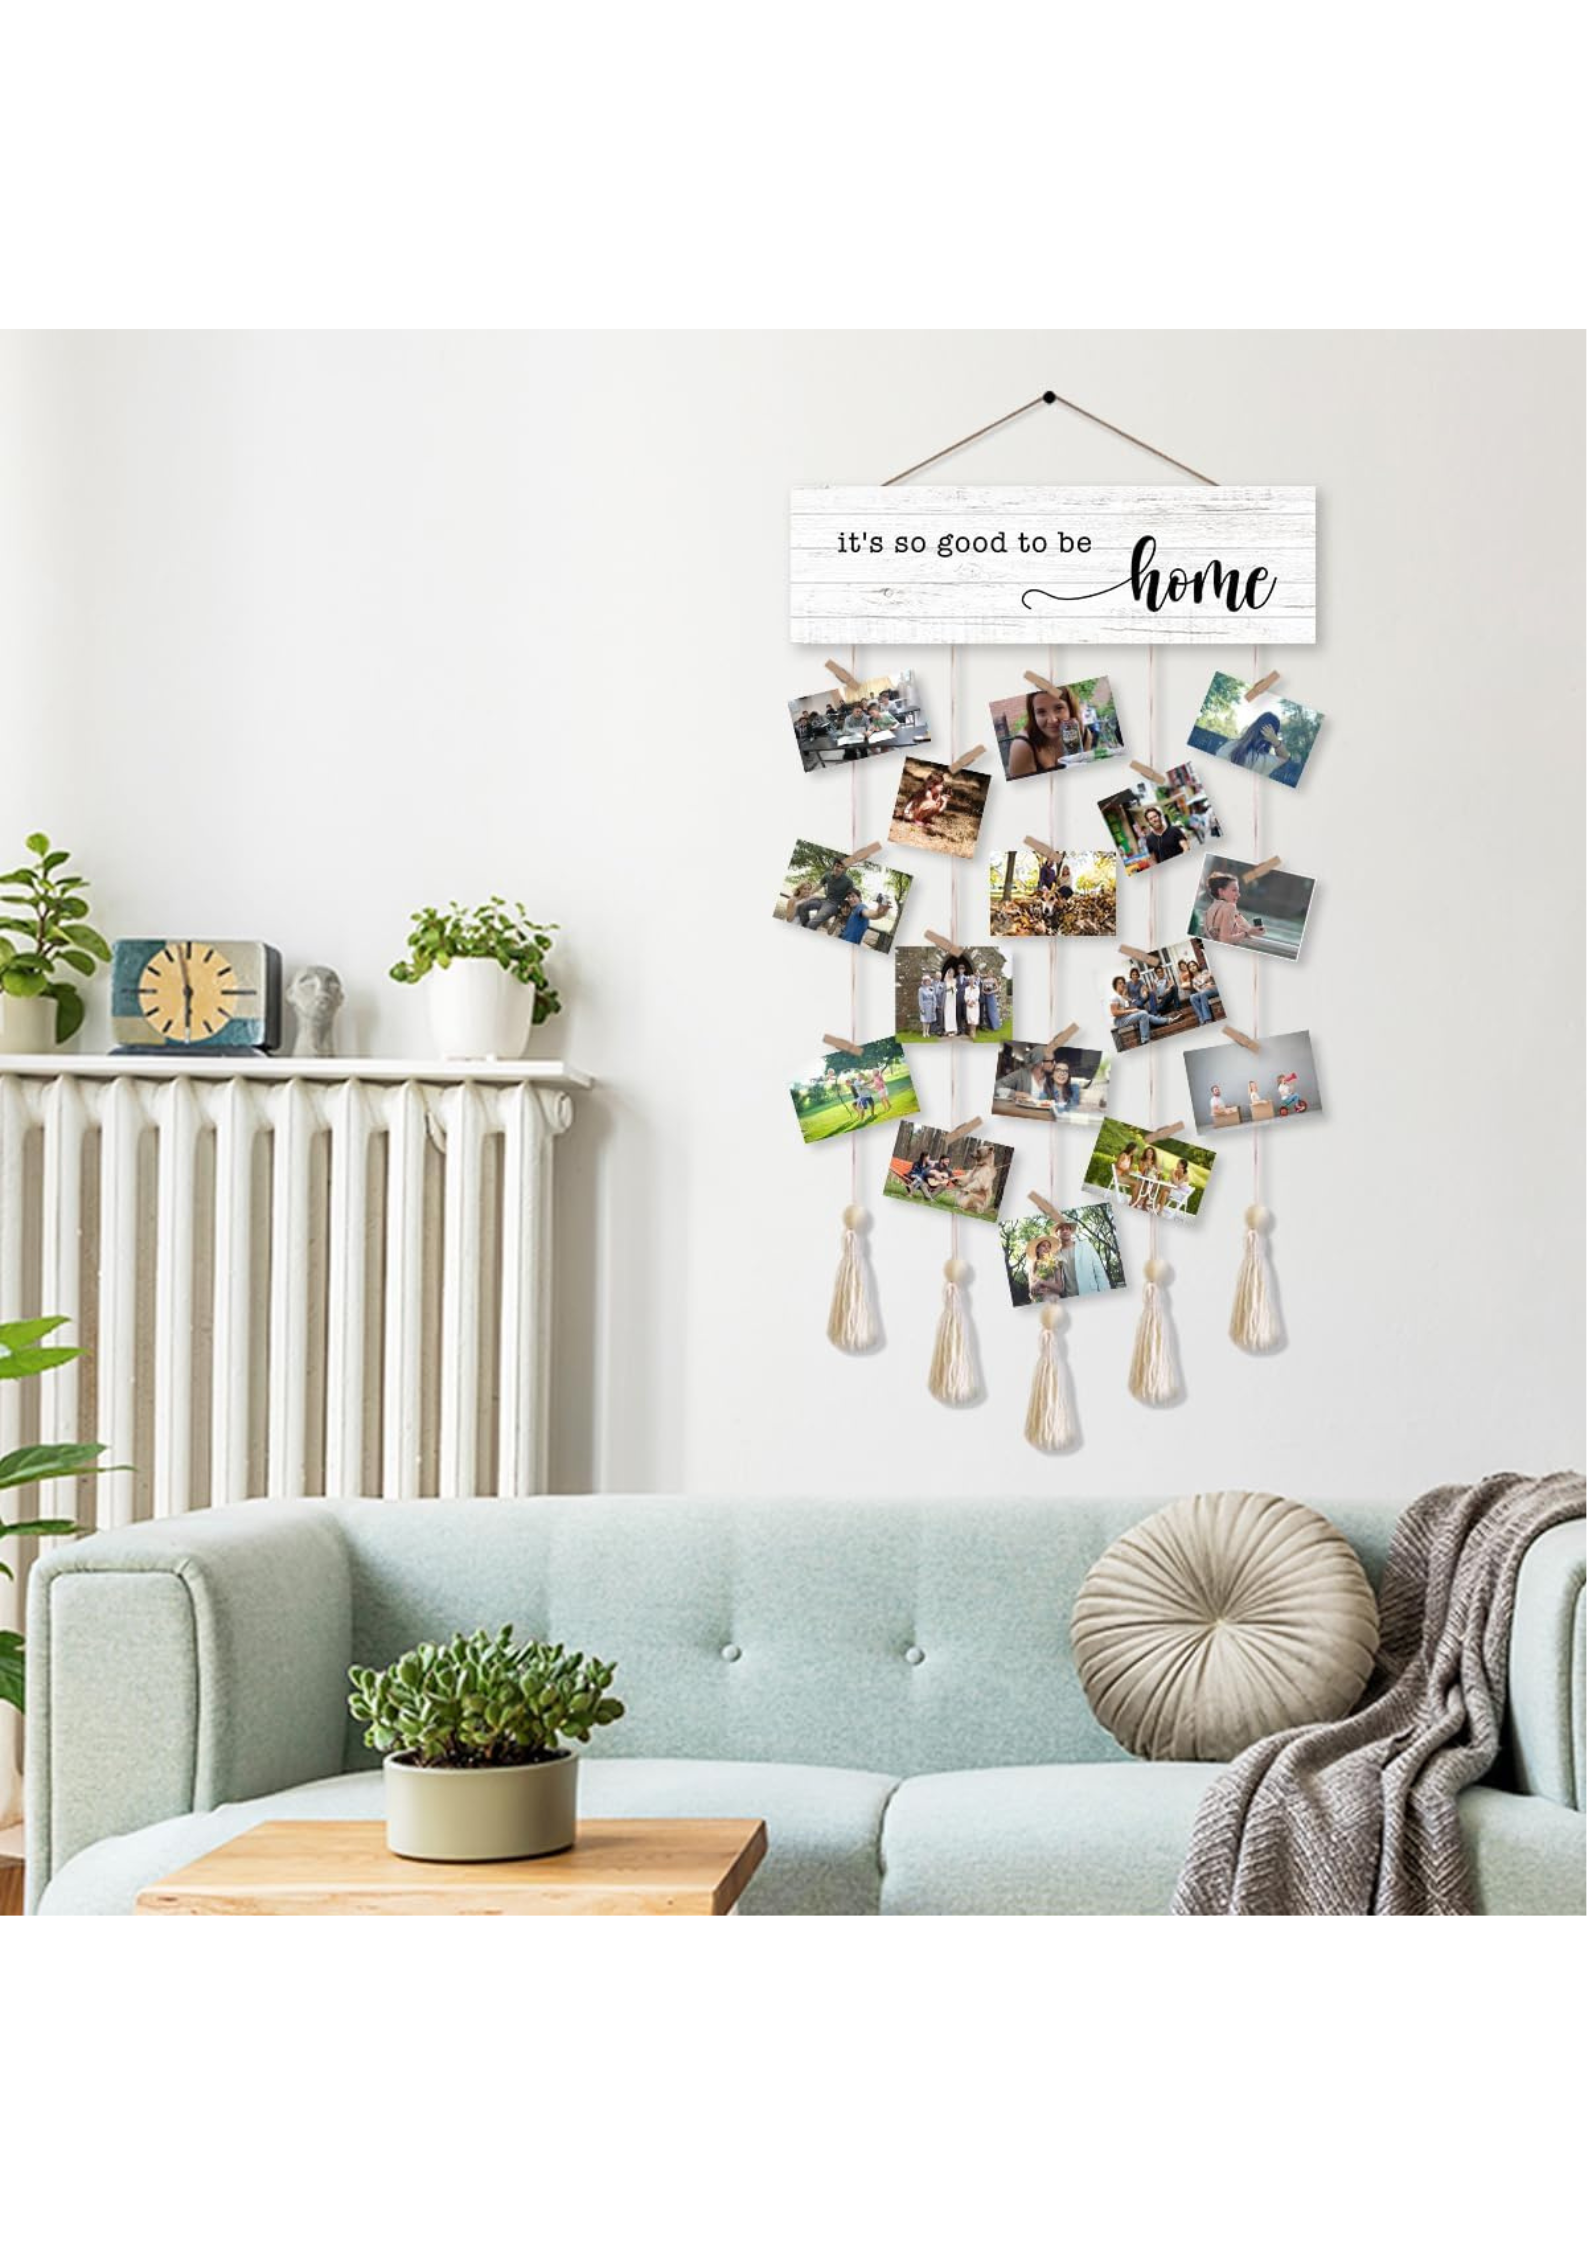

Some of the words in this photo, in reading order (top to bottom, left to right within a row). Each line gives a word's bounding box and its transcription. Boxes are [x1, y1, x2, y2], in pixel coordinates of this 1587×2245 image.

[838, 532, 884, 553] it's
[894, 536, 926, 553] so
[937, 531, 1008, 558] good
[1018, 532, 1047, 553] to
[1058, 531, 1092, 553] be
[1022, 536, 1277, 612] home
